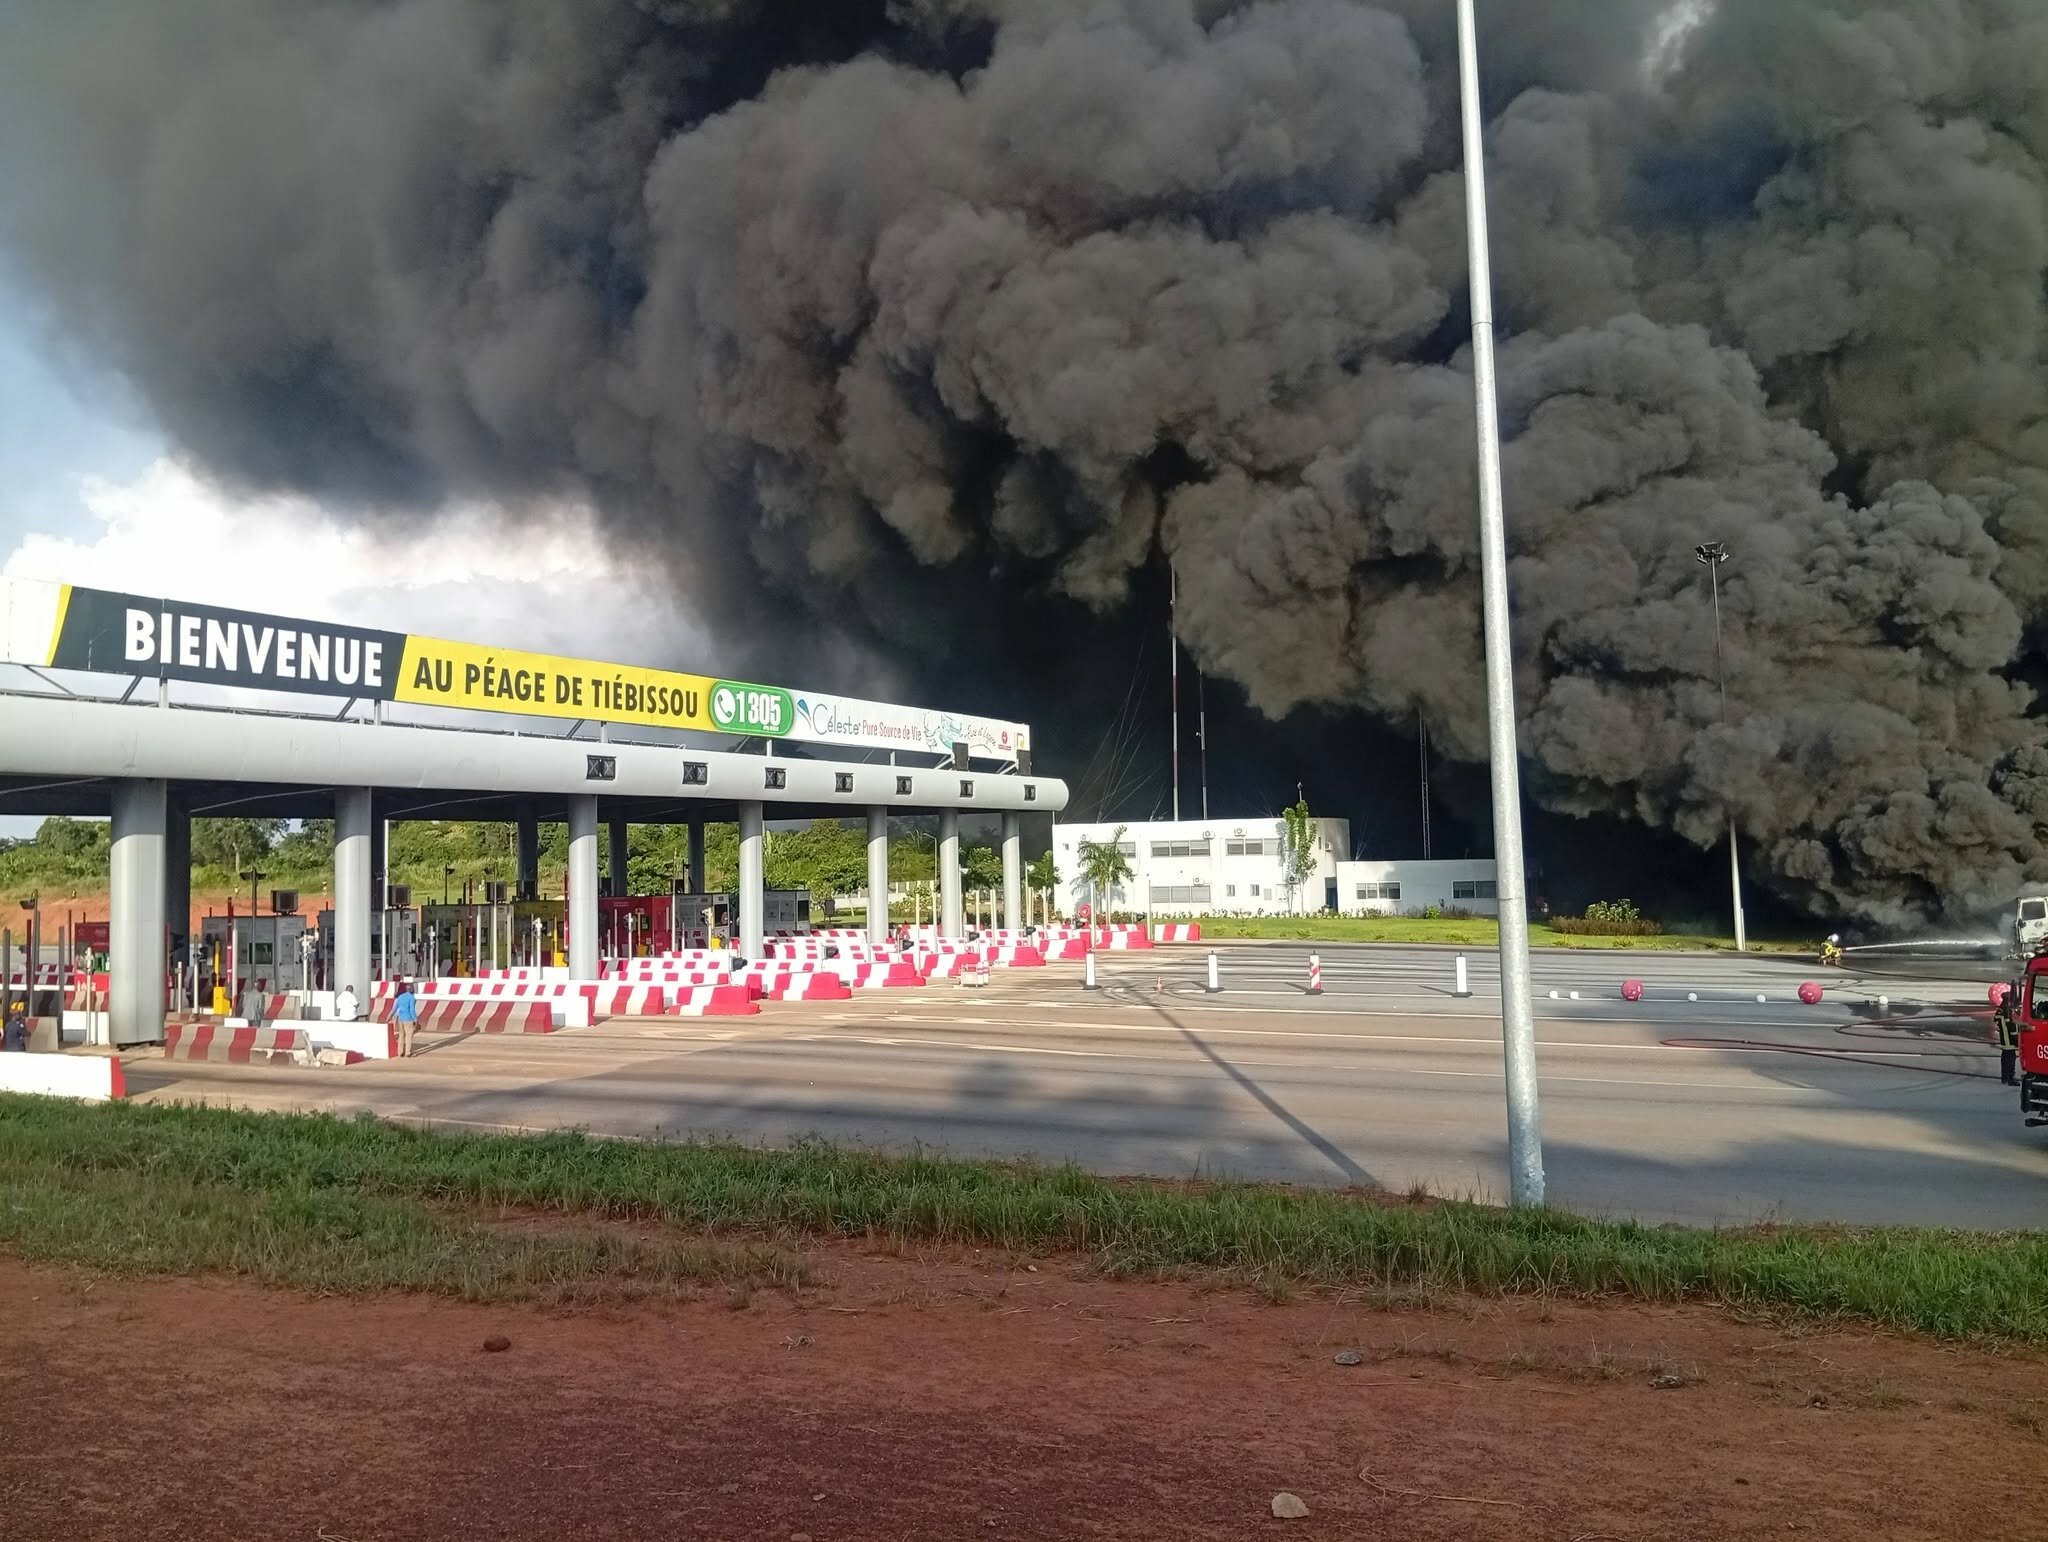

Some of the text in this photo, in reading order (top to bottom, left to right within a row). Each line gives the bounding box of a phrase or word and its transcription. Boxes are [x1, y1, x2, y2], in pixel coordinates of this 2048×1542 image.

[124, 608, 383, 687] BIENVENUE
[413, 657, 698, 718] AU PÉAGE DE TIÉBISSOU
[736, 691, 782, 726] 1305
[812, 703, 922, 741] Céleste Pure Source de Vie
